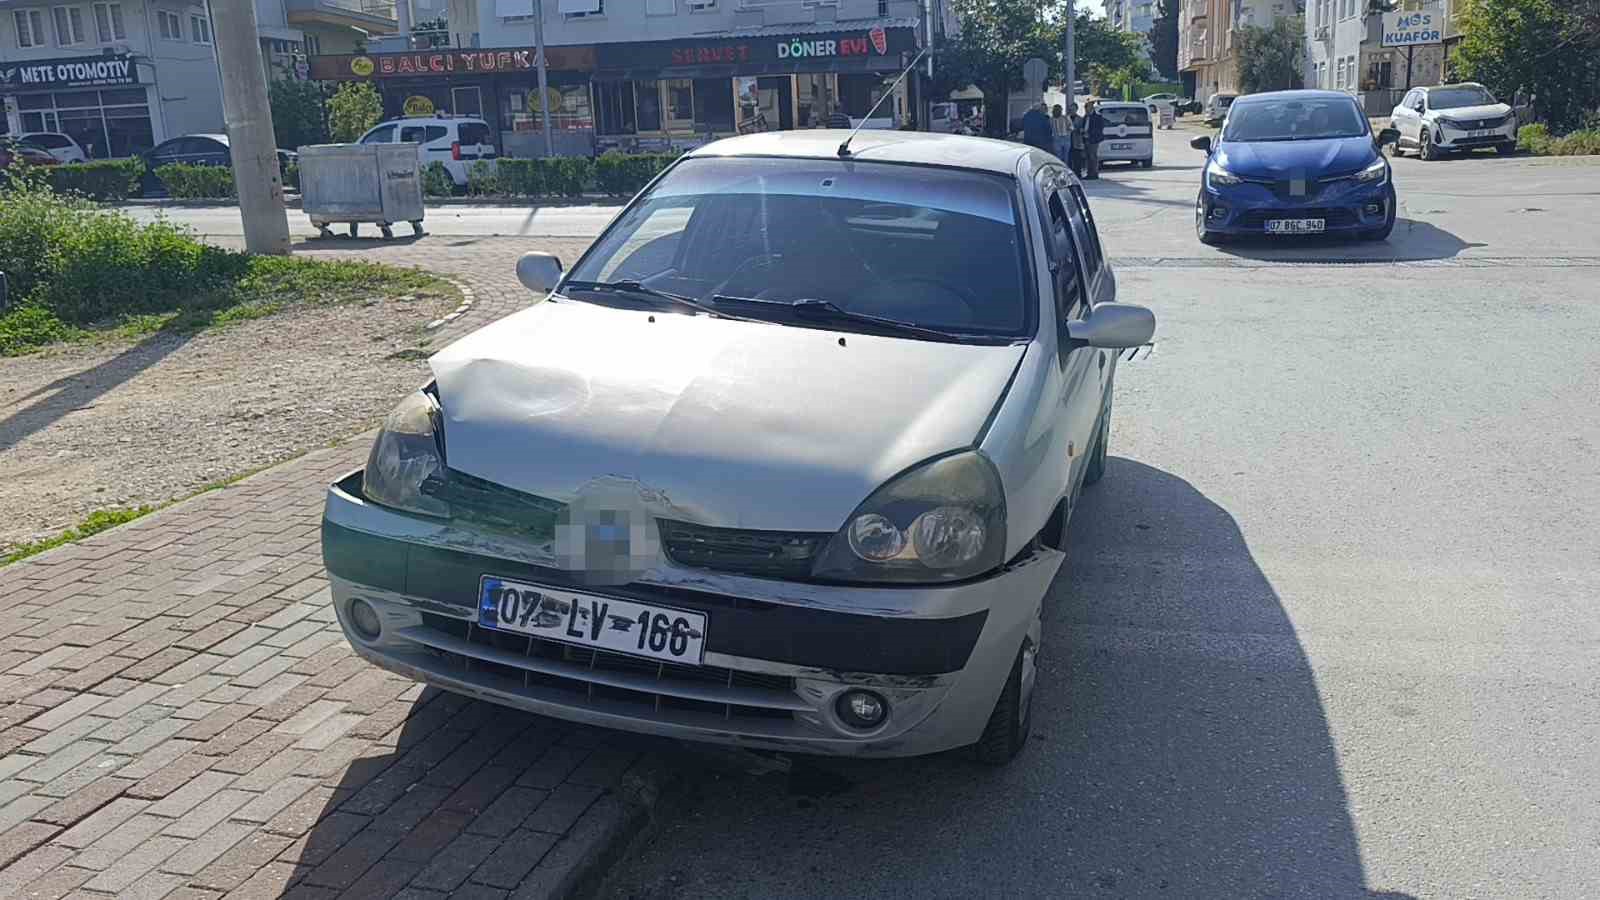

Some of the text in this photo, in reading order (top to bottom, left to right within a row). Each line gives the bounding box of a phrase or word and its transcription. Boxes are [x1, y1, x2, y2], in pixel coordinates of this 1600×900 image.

[778, 38, 836, 58] DÖNER
[380, 55, 454, 73] BALCI
[20, 66, 56, 84] METE
[1270, 221, 1280, 230] 07
[500, 588, 691, 657] 07 LV 166
